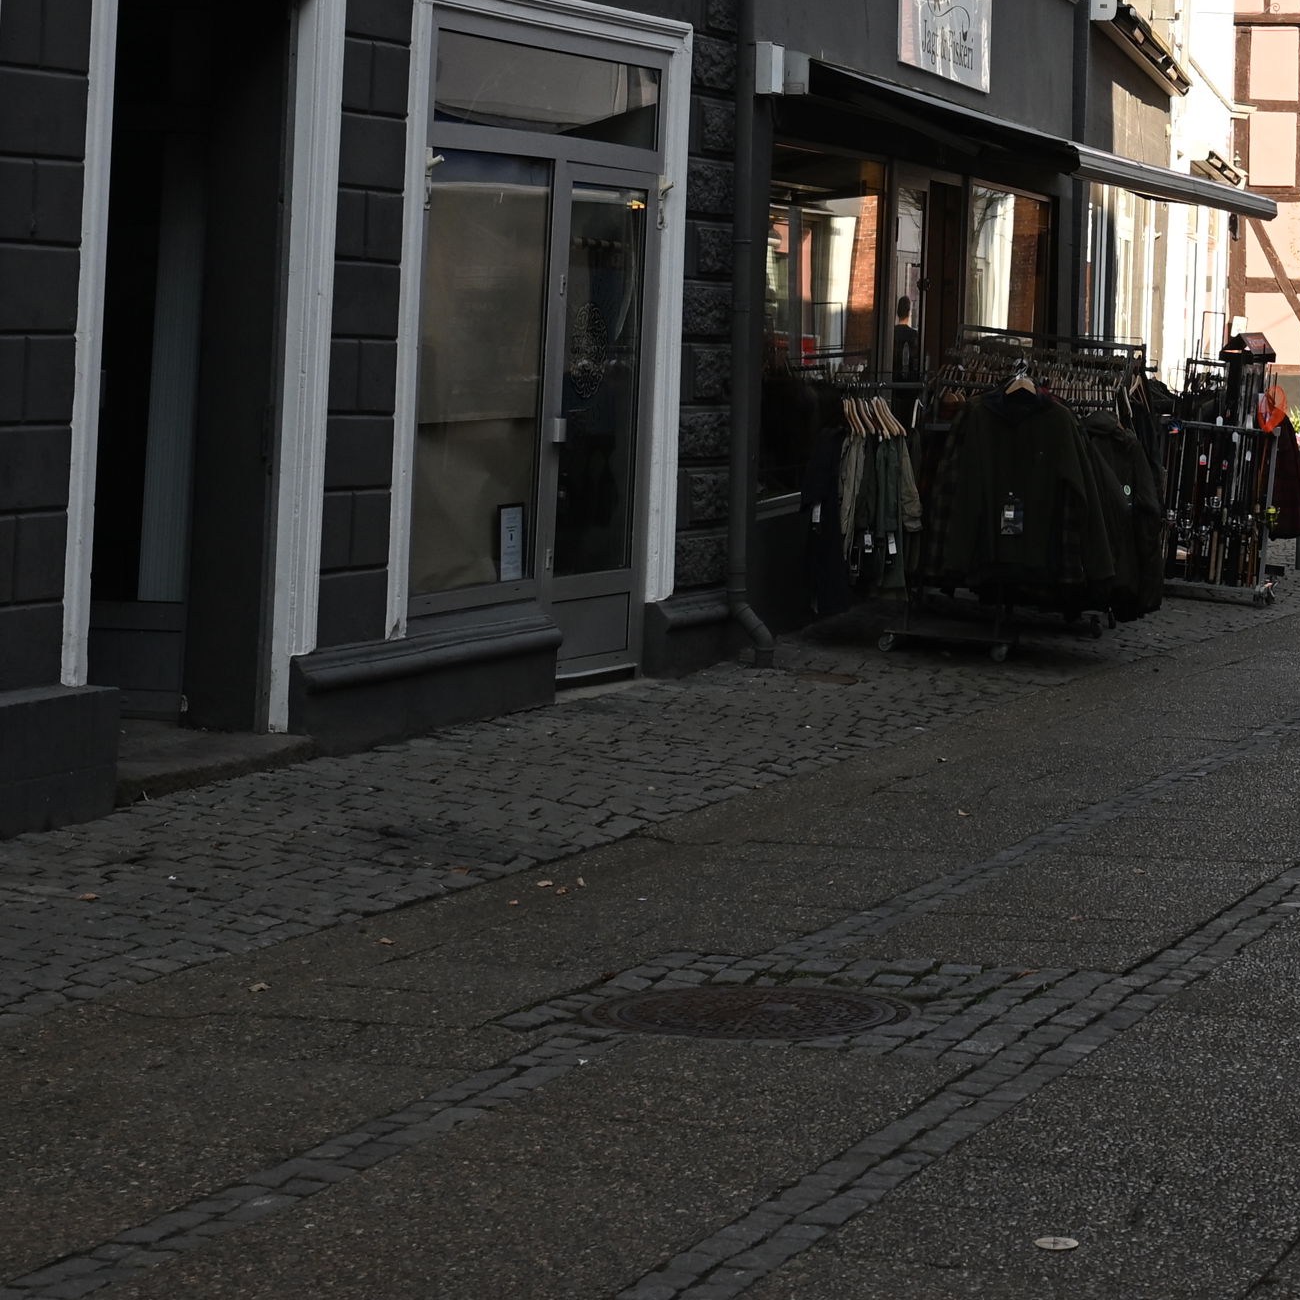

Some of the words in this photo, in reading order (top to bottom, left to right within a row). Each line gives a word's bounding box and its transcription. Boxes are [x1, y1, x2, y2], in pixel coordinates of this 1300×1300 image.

[921, 19, 939, 65] Jagt
[939, 26, 946, 61] &
[947, 30, 974, 70] Fiskeri
